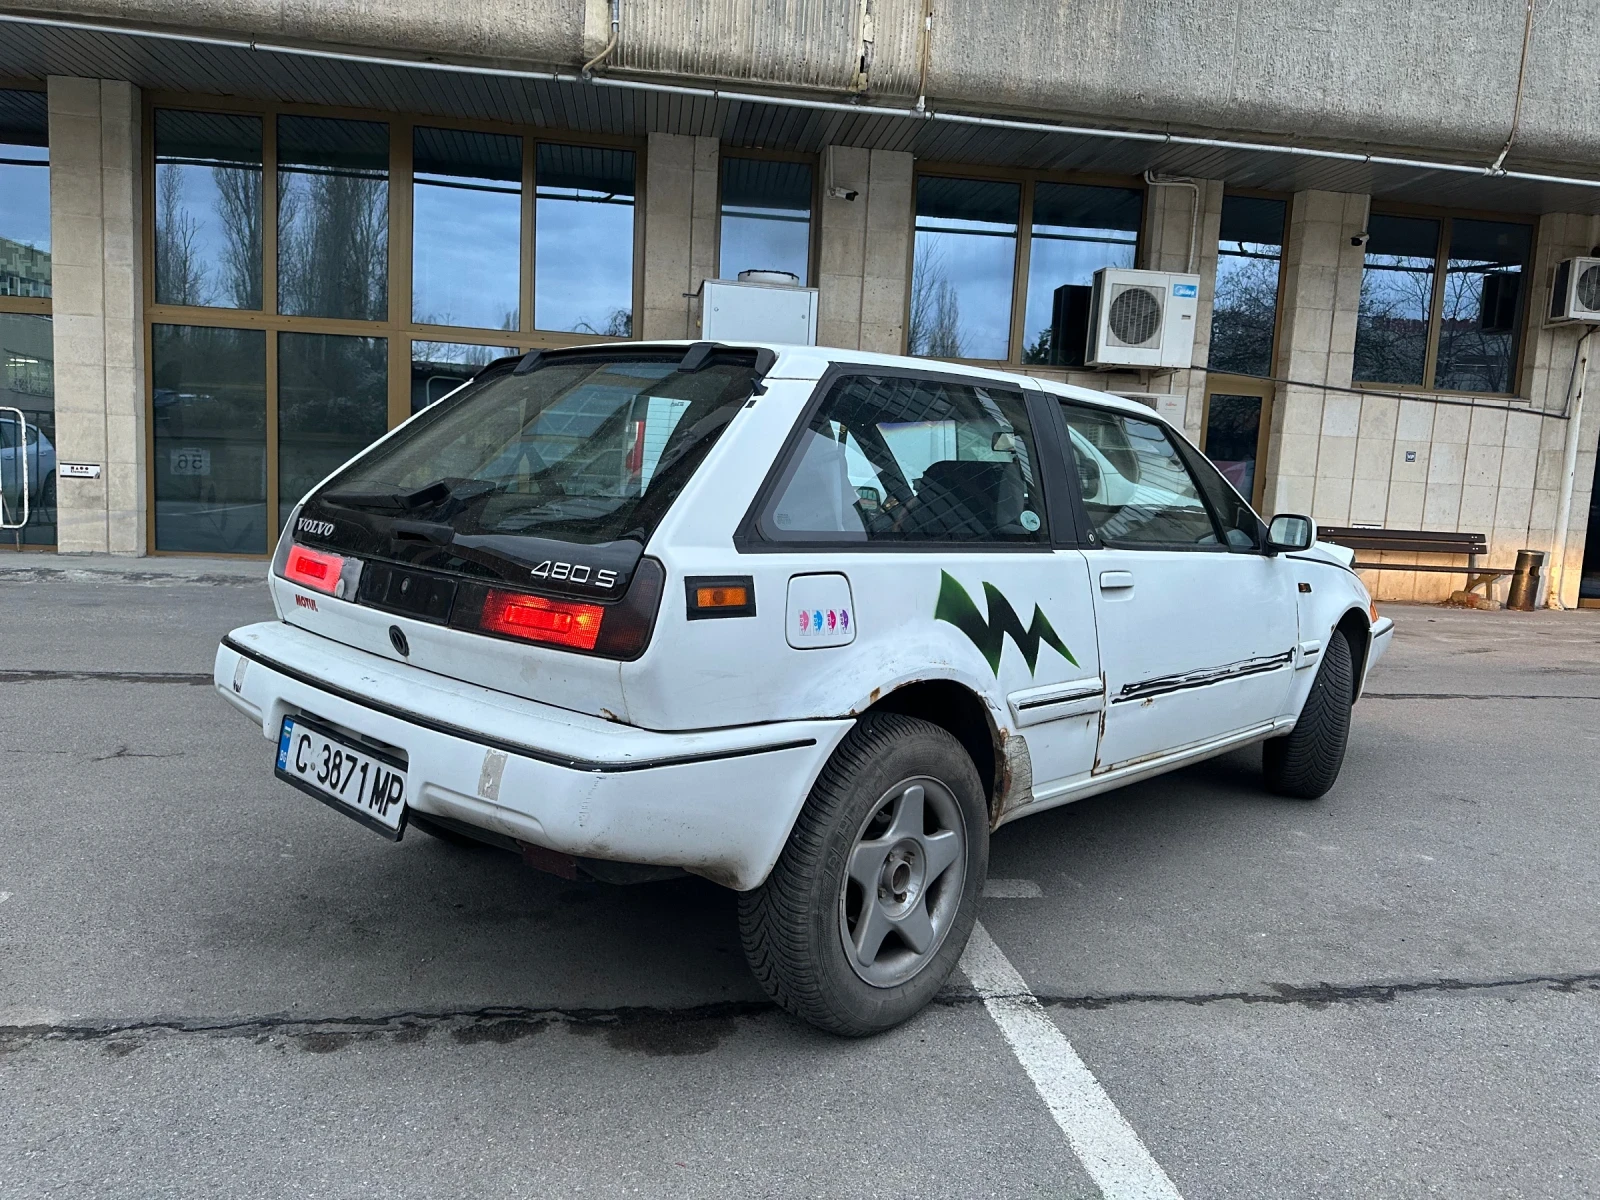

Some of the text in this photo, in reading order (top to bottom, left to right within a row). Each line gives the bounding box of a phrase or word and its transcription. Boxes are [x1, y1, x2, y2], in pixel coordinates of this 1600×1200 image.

[297, 517, 334, 536] VOLVO
[531, 560, 617, 588] 480 S
[295, 594, 318, 612] MOTUL
